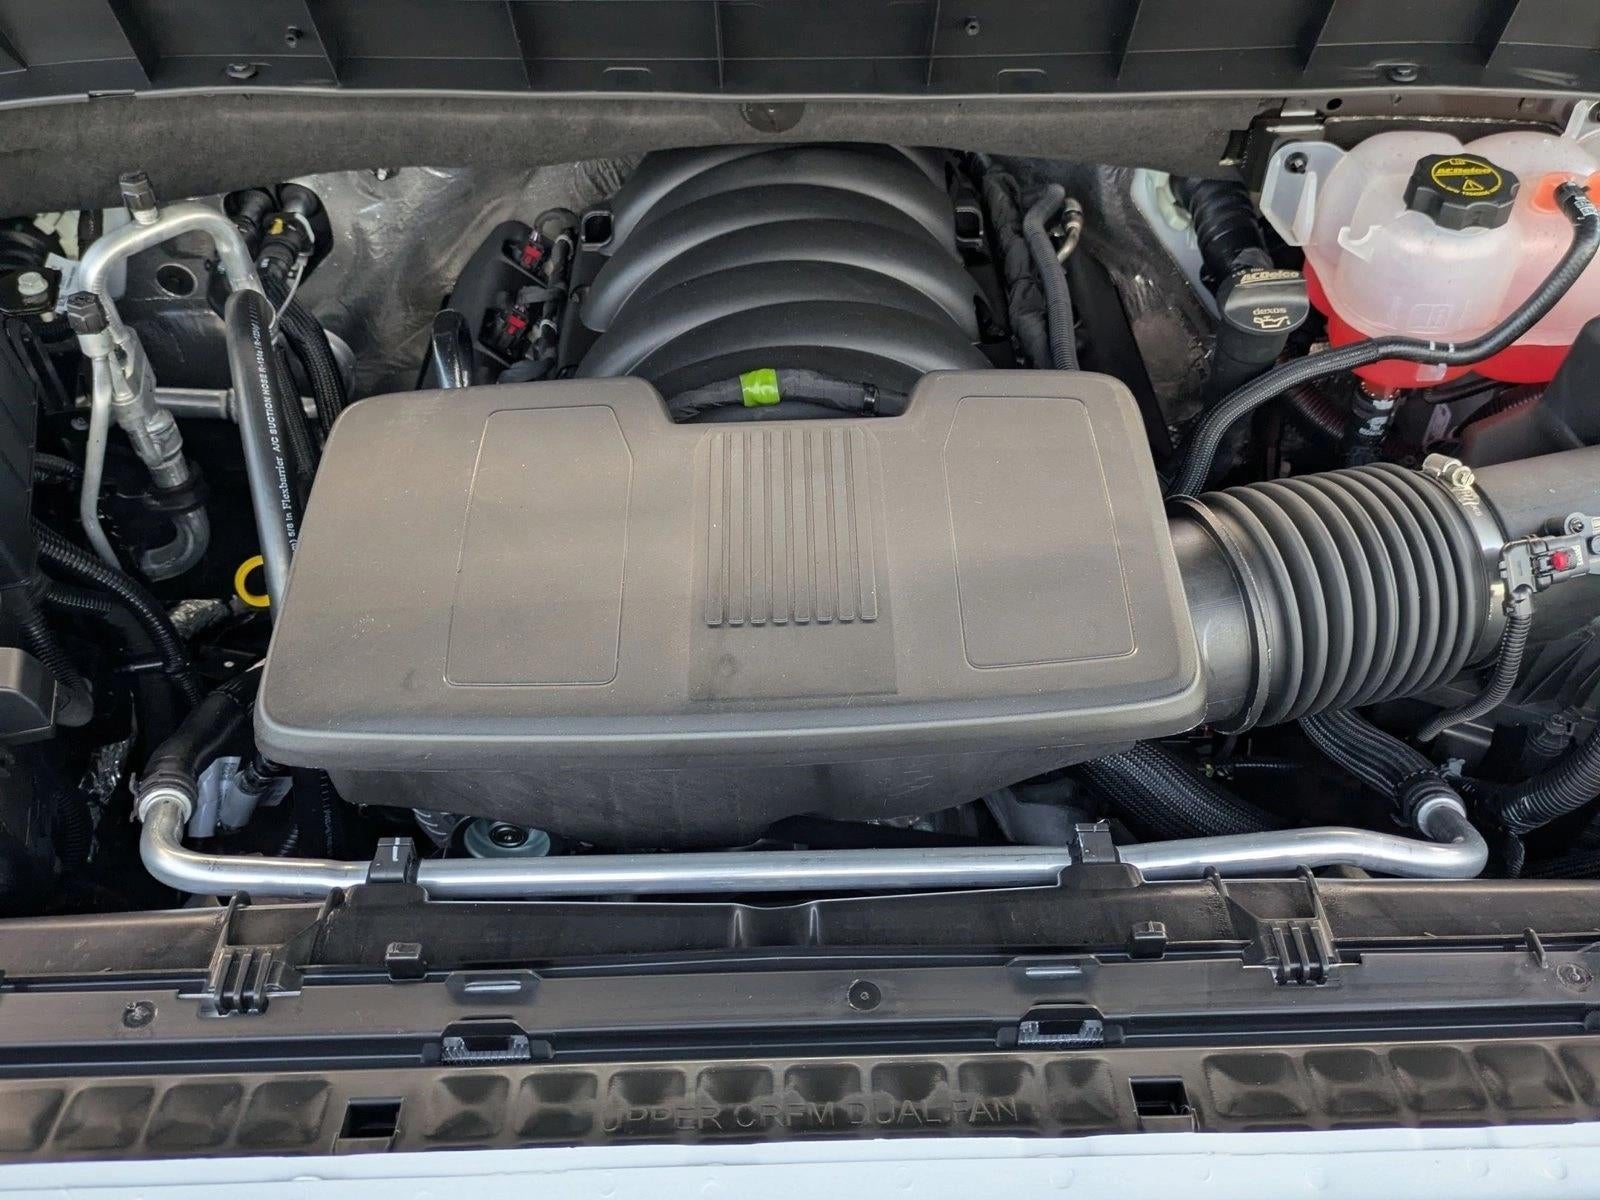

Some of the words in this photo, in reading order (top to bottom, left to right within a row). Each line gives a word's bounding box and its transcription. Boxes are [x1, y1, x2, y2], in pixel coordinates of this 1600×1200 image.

[1240, 270, 1300, 284] ACDelco
[1252, 307, 1288, 316] dexos
[259, 374, 271, 396] HOSE
[263, 397, 278, 435] SUCTION
[270, 436, 281, 452] A/C
[275, 456, 292, 509] Flexbarrier
[286, 523, 296, 538] 5/8
[600, 1106, 723, 1132] UPPER
[847, 1099, 942, 1125] DUAL
[952, 1097, 1019, 1123] FAN
